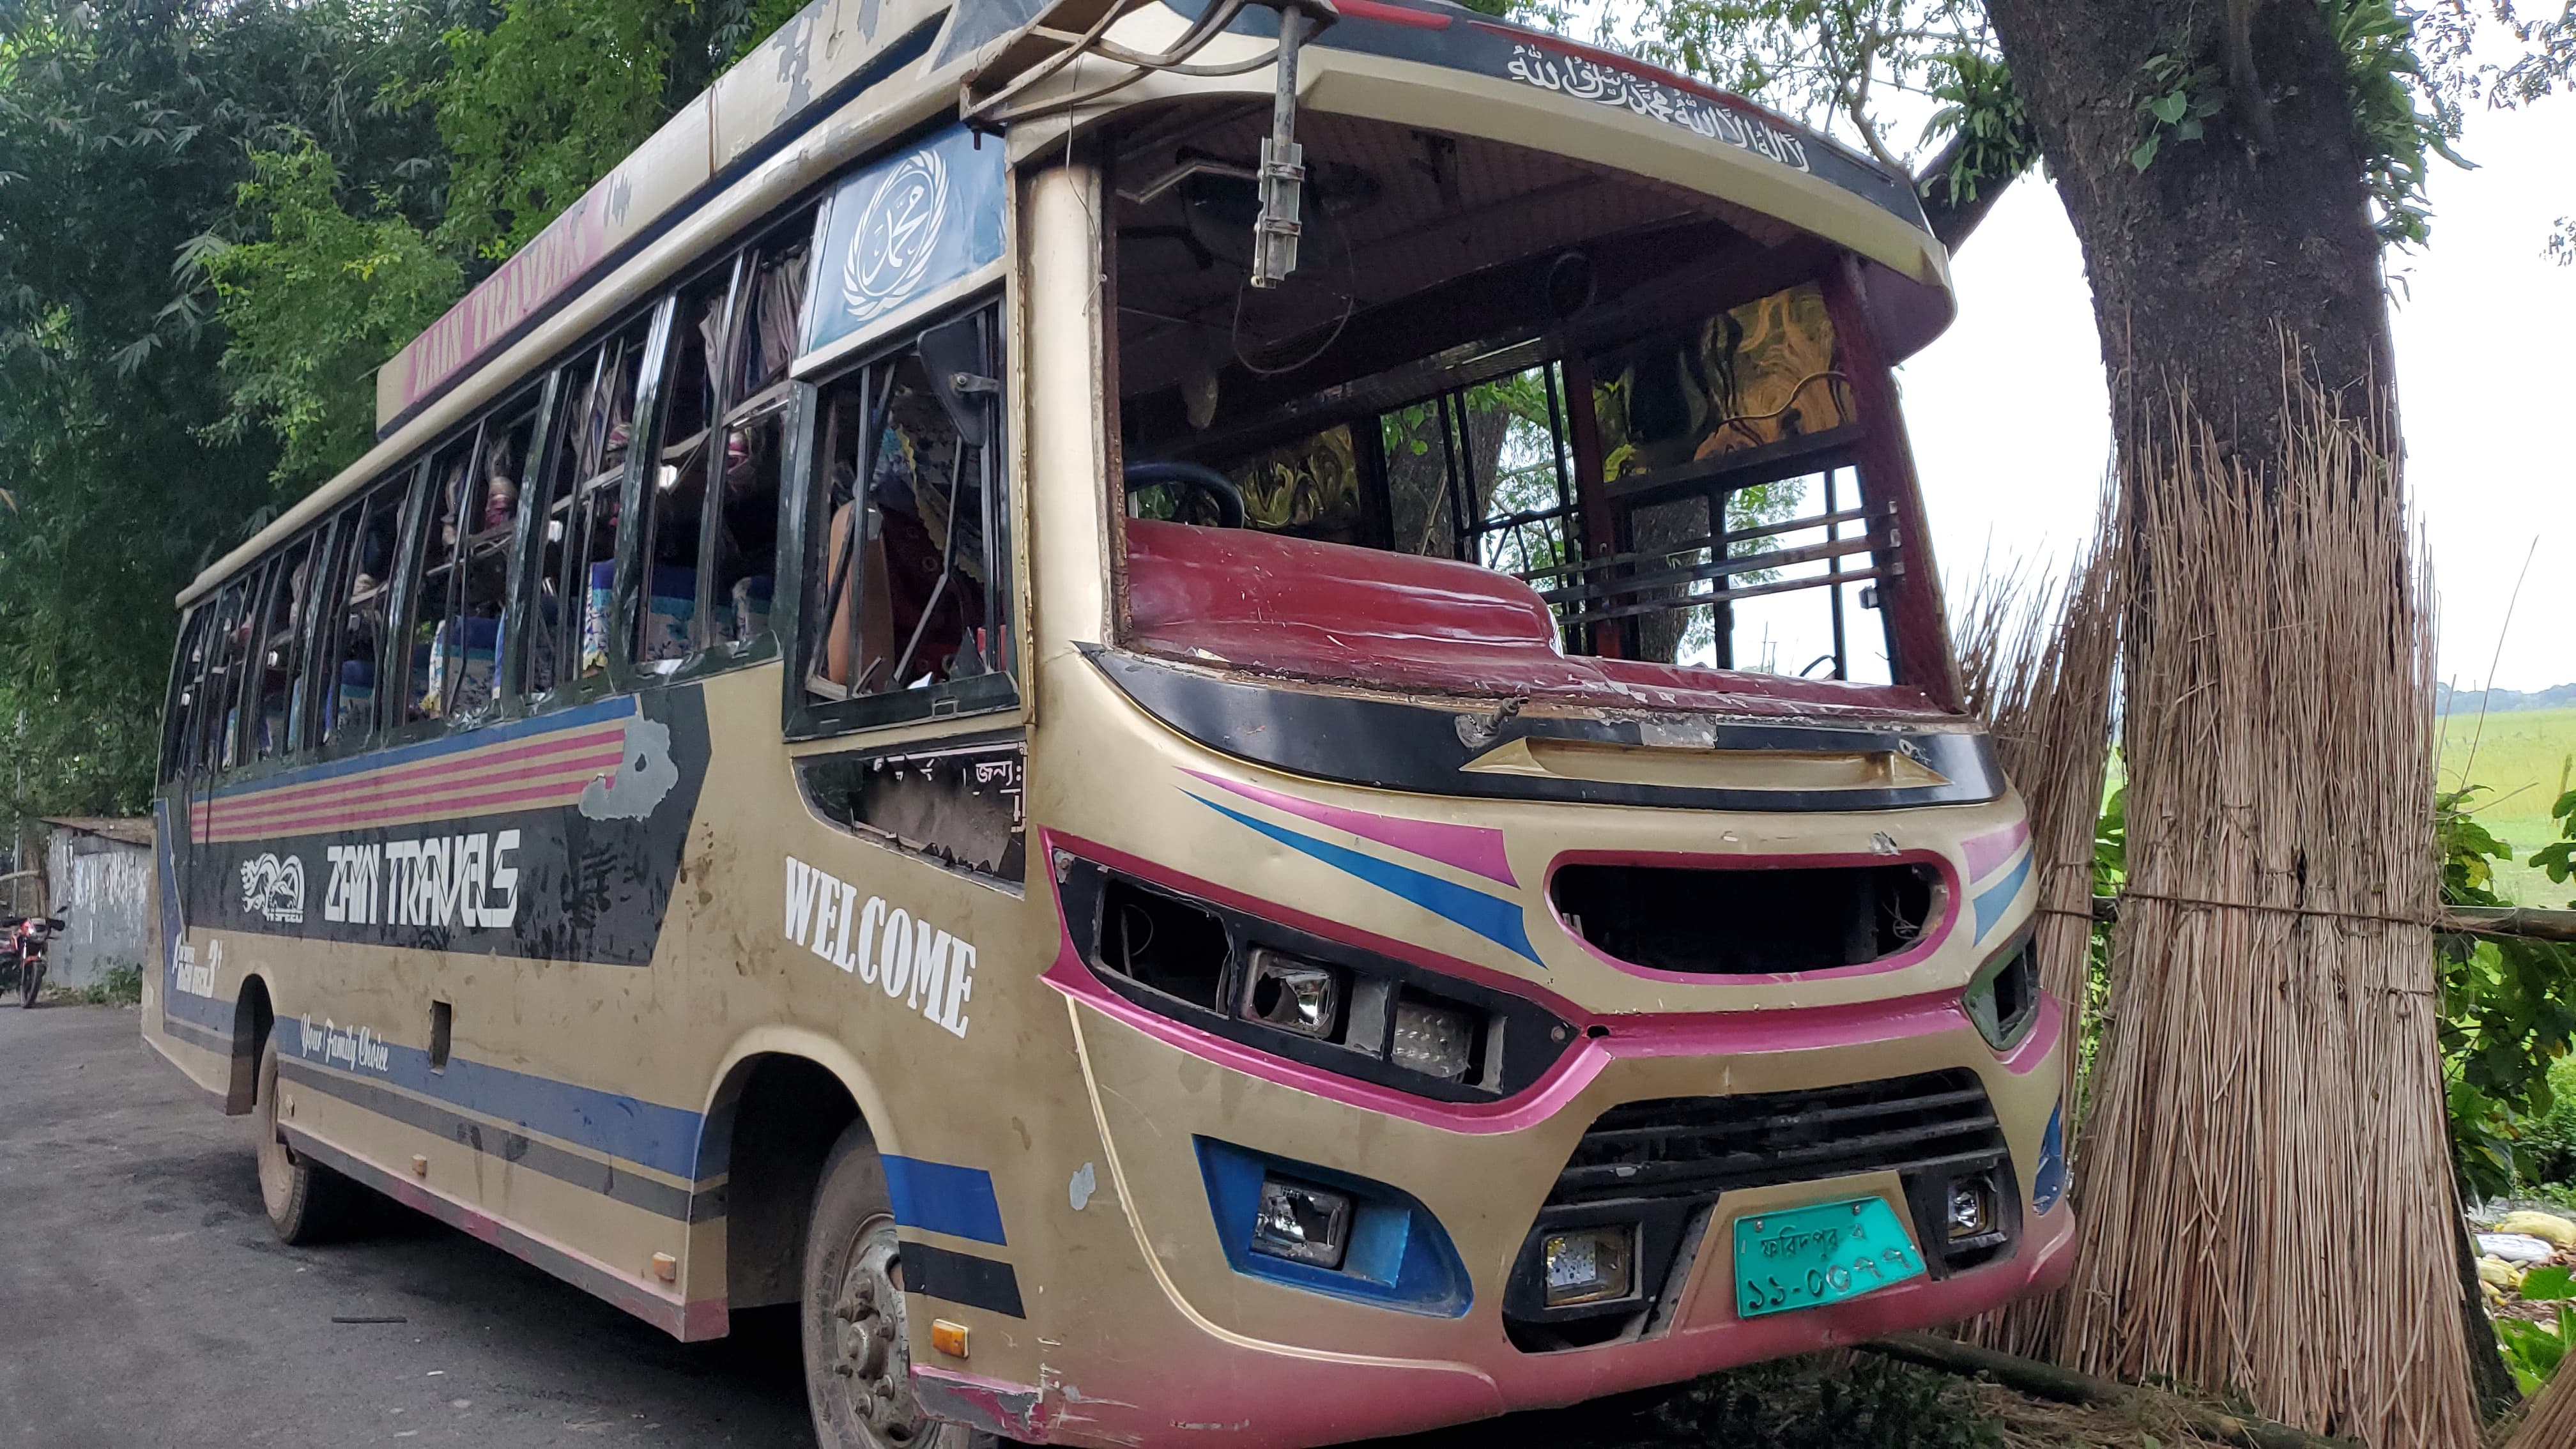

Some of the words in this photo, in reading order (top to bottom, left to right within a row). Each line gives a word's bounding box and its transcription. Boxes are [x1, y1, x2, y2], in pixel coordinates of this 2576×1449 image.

[385, 829, 521, 928] TRAVELS
[786, 855, 977, 1039] WELCOME
[300, 1013, 323, 1058] Your
[323, 1018, 357, 1071] Family
[359, 1025, 388, 1071] Choice
[1761, 1225, 1838, 1259] ফরিদপুর
